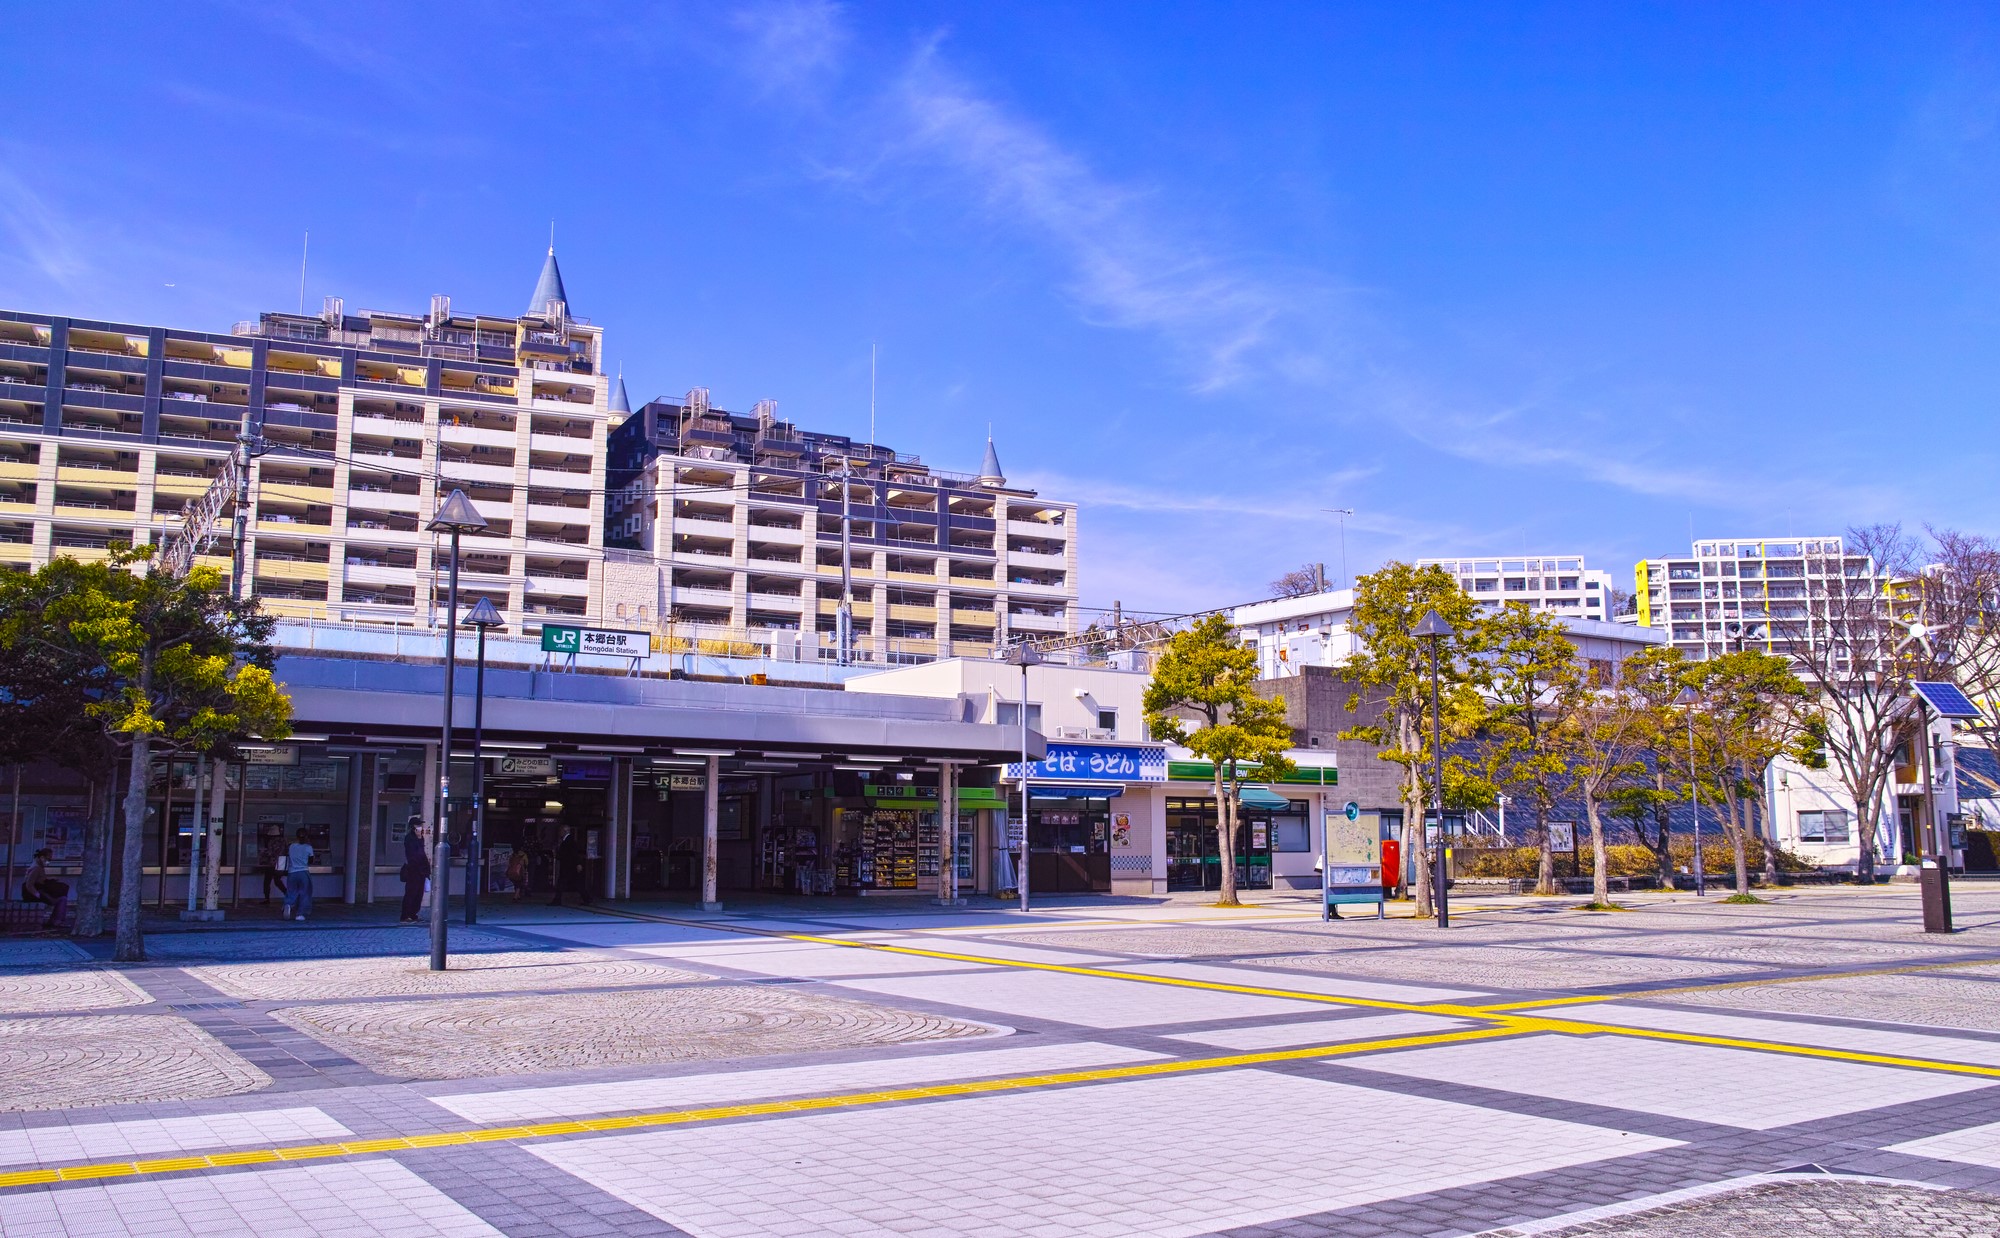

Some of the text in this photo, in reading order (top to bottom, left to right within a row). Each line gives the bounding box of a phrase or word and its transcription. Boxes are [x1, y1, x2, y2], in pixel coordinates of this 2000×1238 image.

[553, 630, 577, 645] JR
[584, 632, 627, 646] 本郷台駅
[1043, 750, 1135, 774] そば・うどん
[654, 776, 670, 786] JR
[672, 776, 705, 786] 本郷台駅
